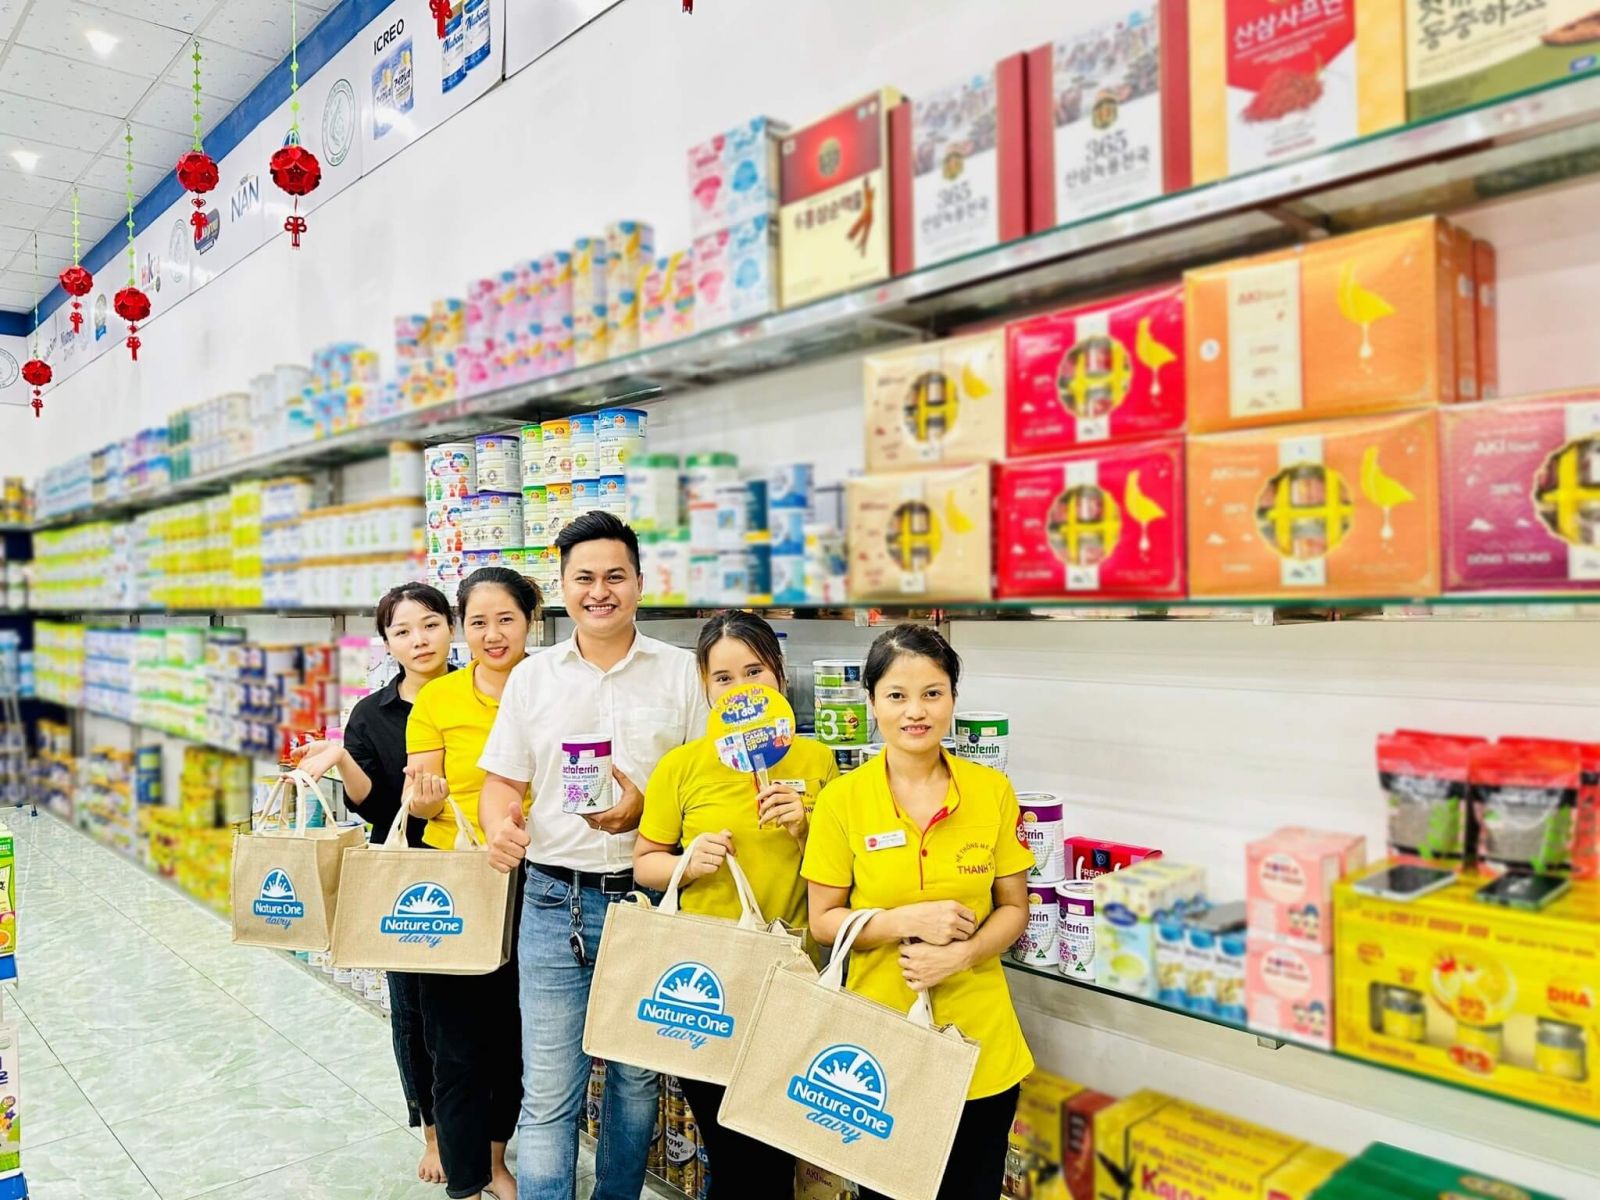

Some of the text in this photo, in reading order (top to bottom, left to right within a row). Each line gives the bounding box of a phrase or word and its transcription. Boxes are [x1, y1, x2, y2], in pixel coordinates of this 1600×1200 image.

[373, 18, 405, 56] ICREO
[231, 175, 259, 223] NAN
[820, 709, 839, 741] 3
[957, 863, 989, 875] THANH
[255, 903, 302, 916] Nature One
[265, 916, 292, 930] dairy
[385, 919, 460, 932] Nature One
[398, 932, 443, 948] dairy
[1547, 985, 1592, 1008] DHA
[642, 1003, 730, 1034] Nature One
[656, 1024, 709, 1049] dairy
[793, 1081, 889, 1134] Nature One
[805, 1109, 863, 1144] dairy
